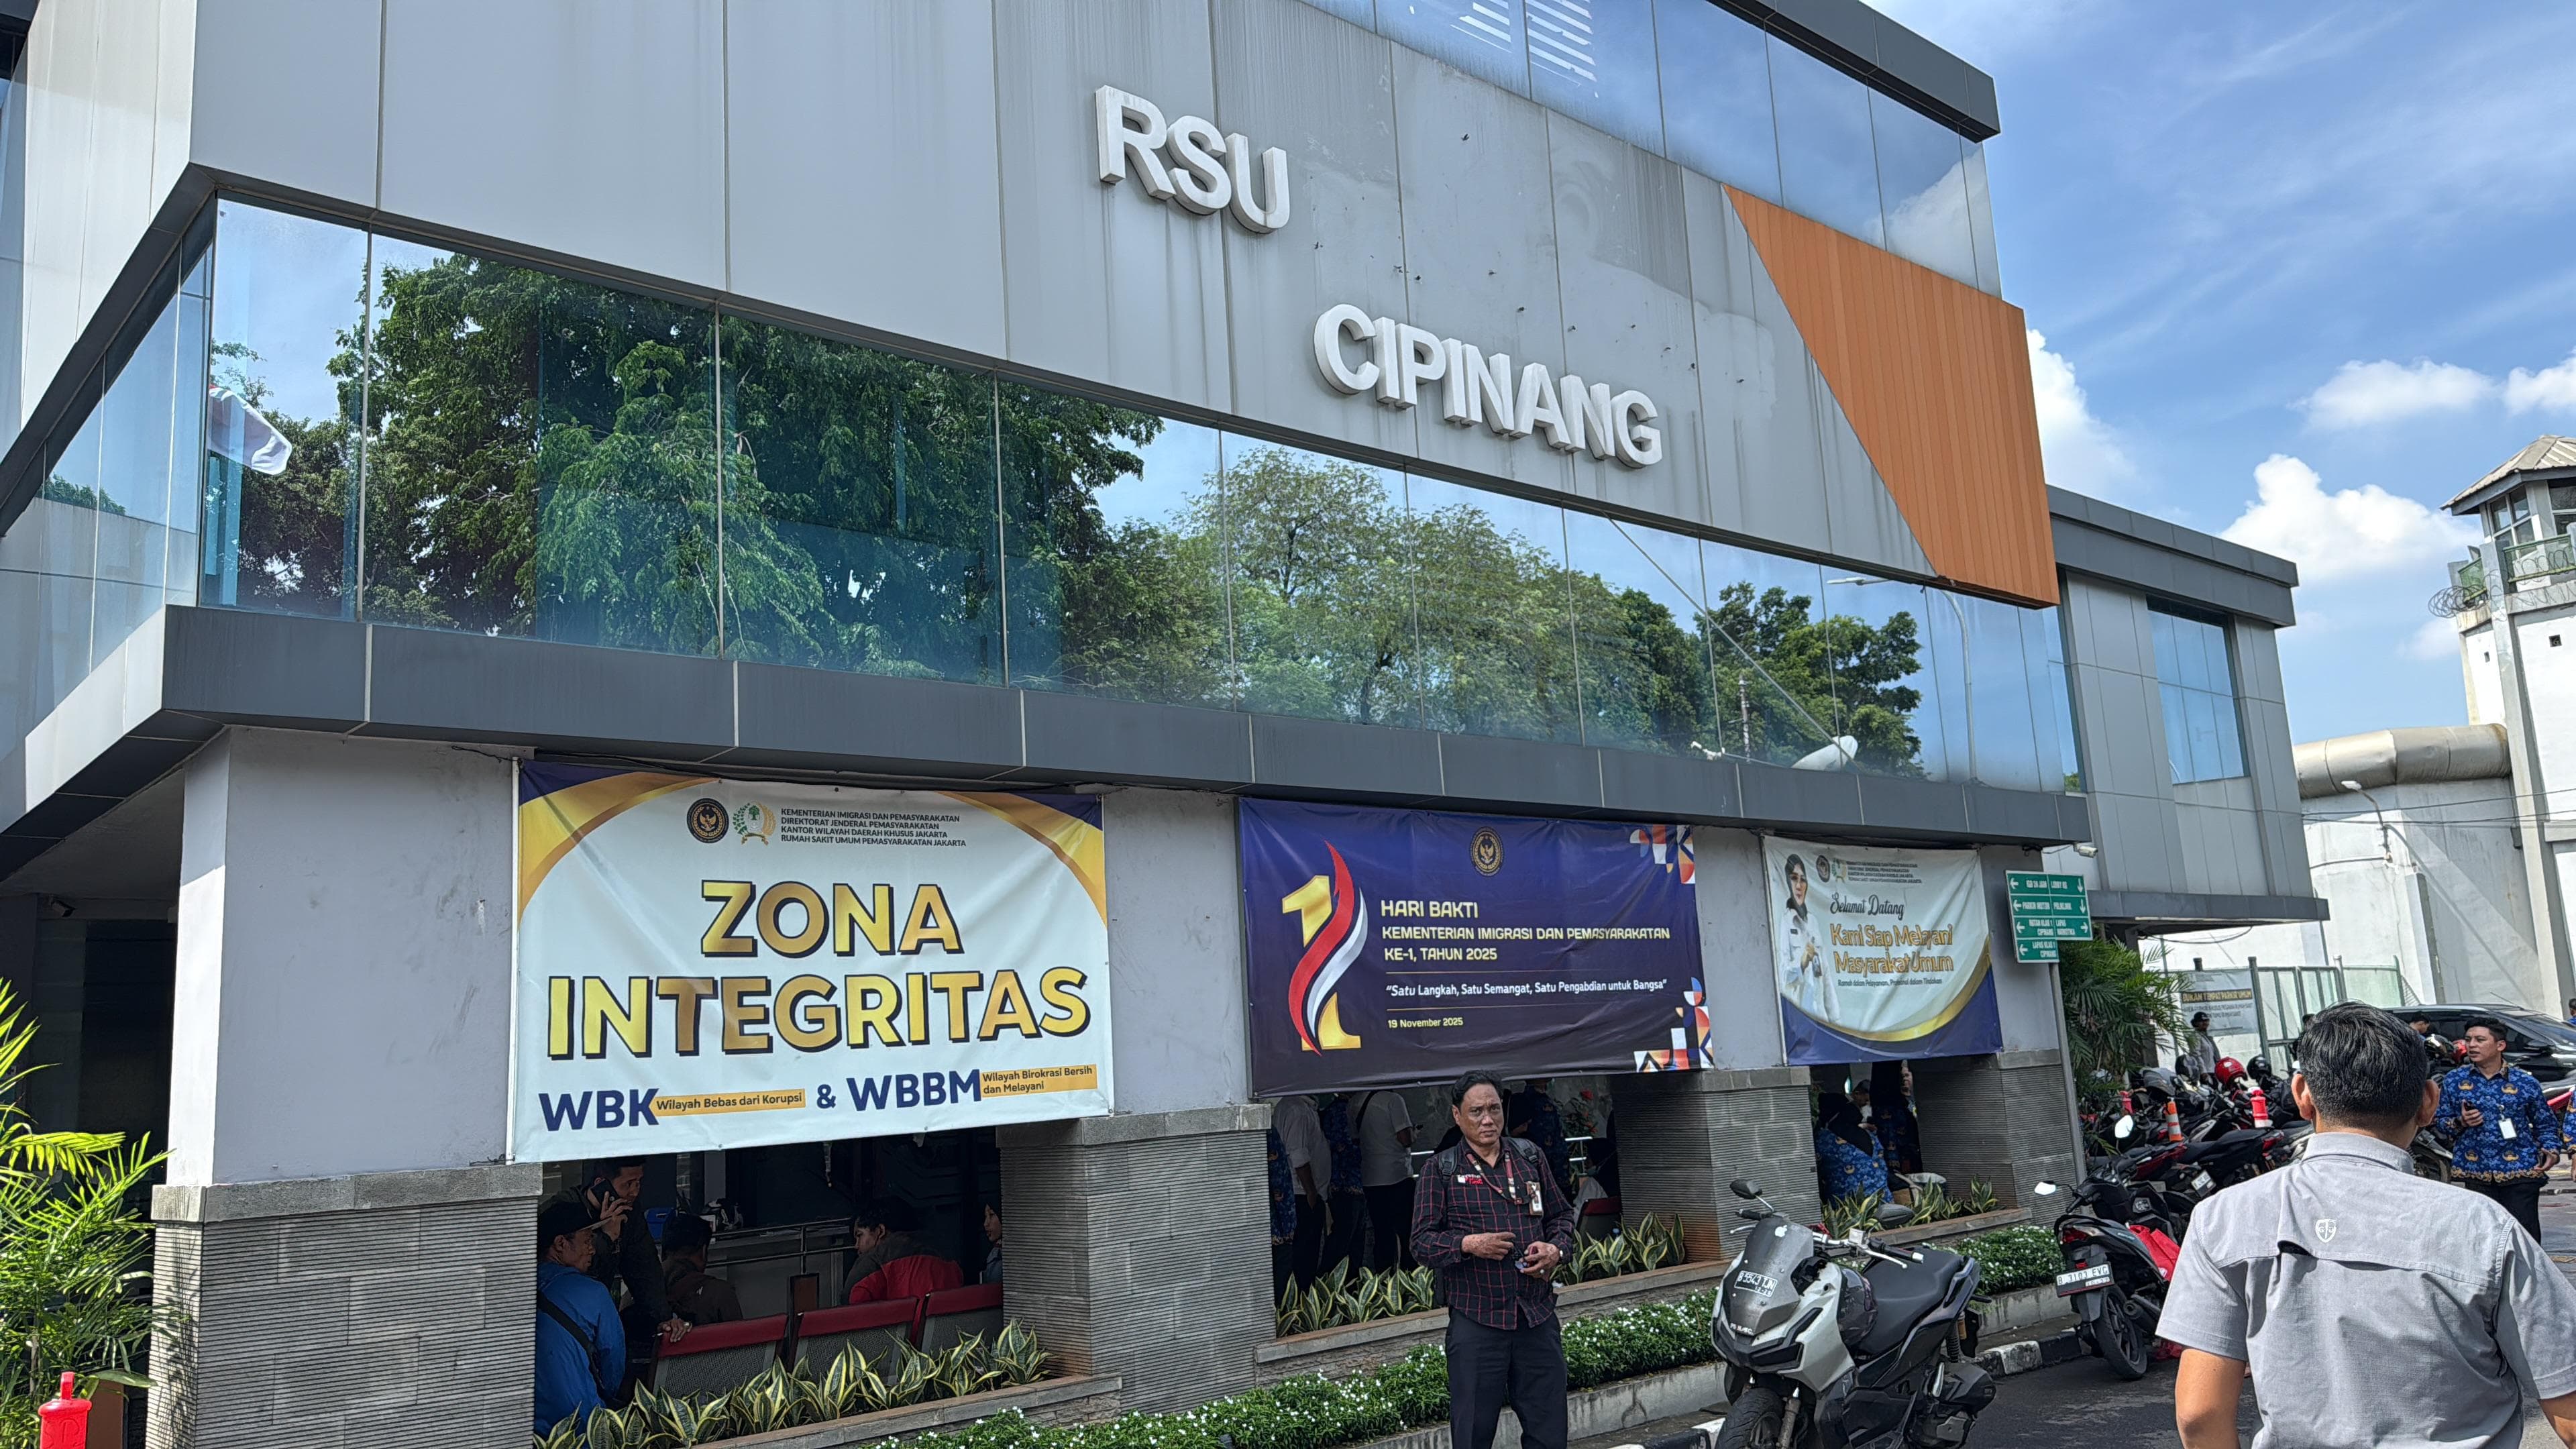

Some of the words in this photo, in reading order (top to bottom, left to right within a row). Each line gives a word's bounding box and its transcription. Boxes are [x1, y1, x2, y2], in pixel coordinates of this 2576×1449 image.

[1096, 85, 1290, 234] RSU
[1313, 304, 1662, 468] CIPINANG
[781, 808, 836, 818] KEMENTERIAN
[837, 811, 871, 819] IMIGRASI
[890, 813, 960, 822] PEMASYARAKATAN
[781, 817, 830, 825] DIREKTORAT
[869, 821, 939, 830] PEMASYARAKATAN
[781, 826, 814, 834] KANTOR
[815, 827, 850, 835] WILAYAH
[781, 835, 810, 843] RUMAH
[862, 837, 932, 846] PEMASYARAKATAN
[1381, 900, 1424, 917] HARI
[1429, 900, 1479, 918] BAKTI
[1830, 892, 1868, 914] Selamat
[1868, 894, 1904, 920] Datang
[701, 879, 964, 957] ZONA
[1382, 926, 1474, 939] KEMENTERIAN
[1478, 927, 1533, 940] IMIGRASI
[1536, 928, 1563, 939] DAN
[1567, 927, 1670, 939] PEMASYARAKATAN
[1830, 923, 1865, 947] Kami
[1864, 924, 1893, 951] Siap
[1893, 924, 1953, 950] Melayani
[1384, 947, 1417, 962] KE-1,
[1420, 948, 1462, 961] TAHUN
[1466, 948, 1497, 961] 2025
[1833, 951, 1912, 978] Masyarakat
[1911, 951, 1954, 973] Umum
[1417, 984, 1459, 998] Langkah,
[1461, 983, 1482, 995] Satu
[1484, 983, 1533, 996] Semangat,
[1535, 982, 1556, 993] Satu
[1558, 981, 1607, 994] Pengabdian
[1608, 979, 1631, 990] untuk
[547, 966, 1091, 1061] INTEGRITAS
[1388, 1020, 1397, 1028] 19
[1400, 1018, 1441, 1028] November
[1443, 1017, 1463, 1026] 2025
[982, 1071, 1020, 1083] Wilayah
[1022, 1067, 1063, 1079] Birokrasi
[1064, 1065, 1093, 1076] Bersih
[816, 1084, 837, 1109] &
[847, 1069, 982, 1112] WBBM
[983, 1084, 1002, 1094] dan
[1003, 1081, 1044, 1093] Melayani
[538, 1088, 660, 1132] WBK
[656, 1099, 701, 1112] Wilayah
[704, 1097, 737, 1108] Bebas
[739, 1095, 760, 1106] dari
[762, 1091, 803, 1105] Korupsi
